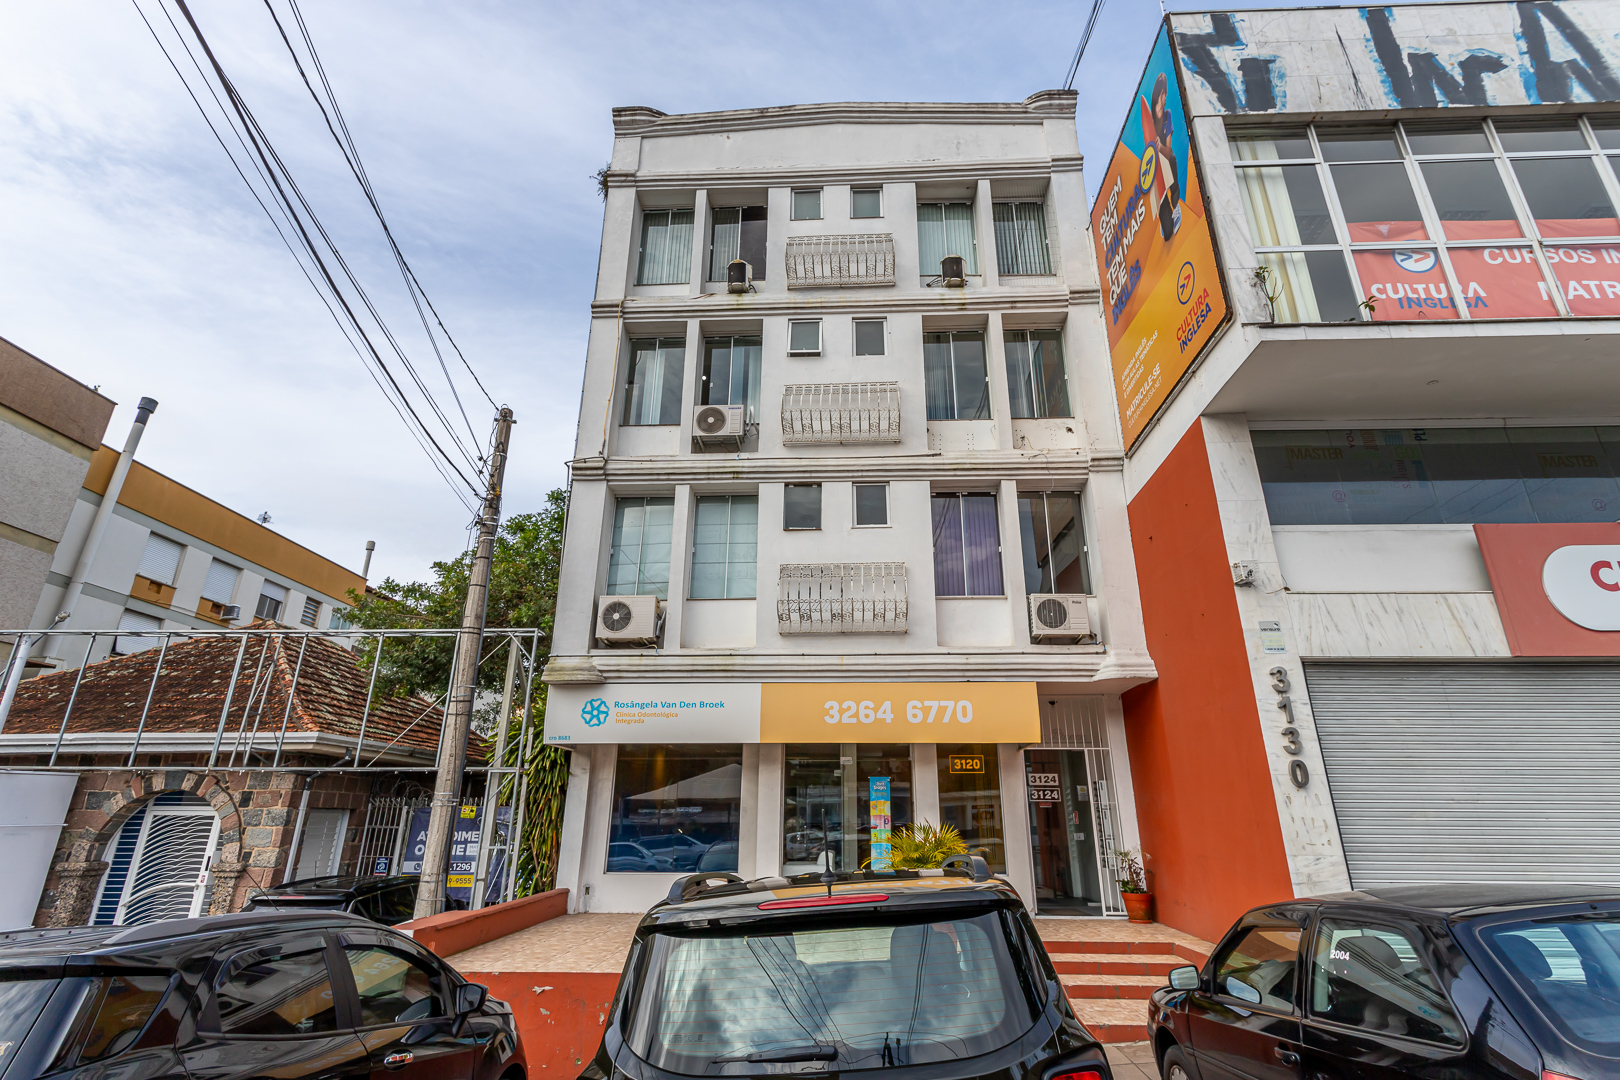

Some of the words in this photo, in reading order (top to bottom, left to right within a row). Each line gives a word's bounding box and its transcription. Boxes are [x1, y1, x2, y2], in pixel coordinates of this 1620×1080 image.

[1100, 175, 1122, 235] QUEM
[1105, 184, 1141, 269] CULTURA
[1101, 207, 1118, 251] TEM
[1106, 246, 1124, 287] TEM
[1122, 199, 1146, 256] MAIS
[1110, 262, 1128, 306] QUE
[1112, 259, 1141, 326] INGLÊS
[1176, 287, 1210, 342] CULTURA
[1179, 302, 1212, 354] INGLESA
[1126, 362, 1161, 420] MATRICULE-SE
[1290, 446, 1345, 460] MASTER
[1541, 454, 1599, 468] MASTER
[614, 701, 658, 710] Rosângela
[660, 701, 677, 709] Van
[679, 701, 697, 709] Den
[699, 701, 725, 709] Broek
[637, 711, 678, 719] Odontológica
[823, 700, 894, 724] 3264
[906, 700, 973, 724] 6770
[1269, 666, 1309, 789] 3130
[954, 759, 980, 770] 3120
[1030, 775, 1057, 784] 3124
[1031, 790, 1059, 799] 3124
[1329, 949, 1350, 960] 2004
